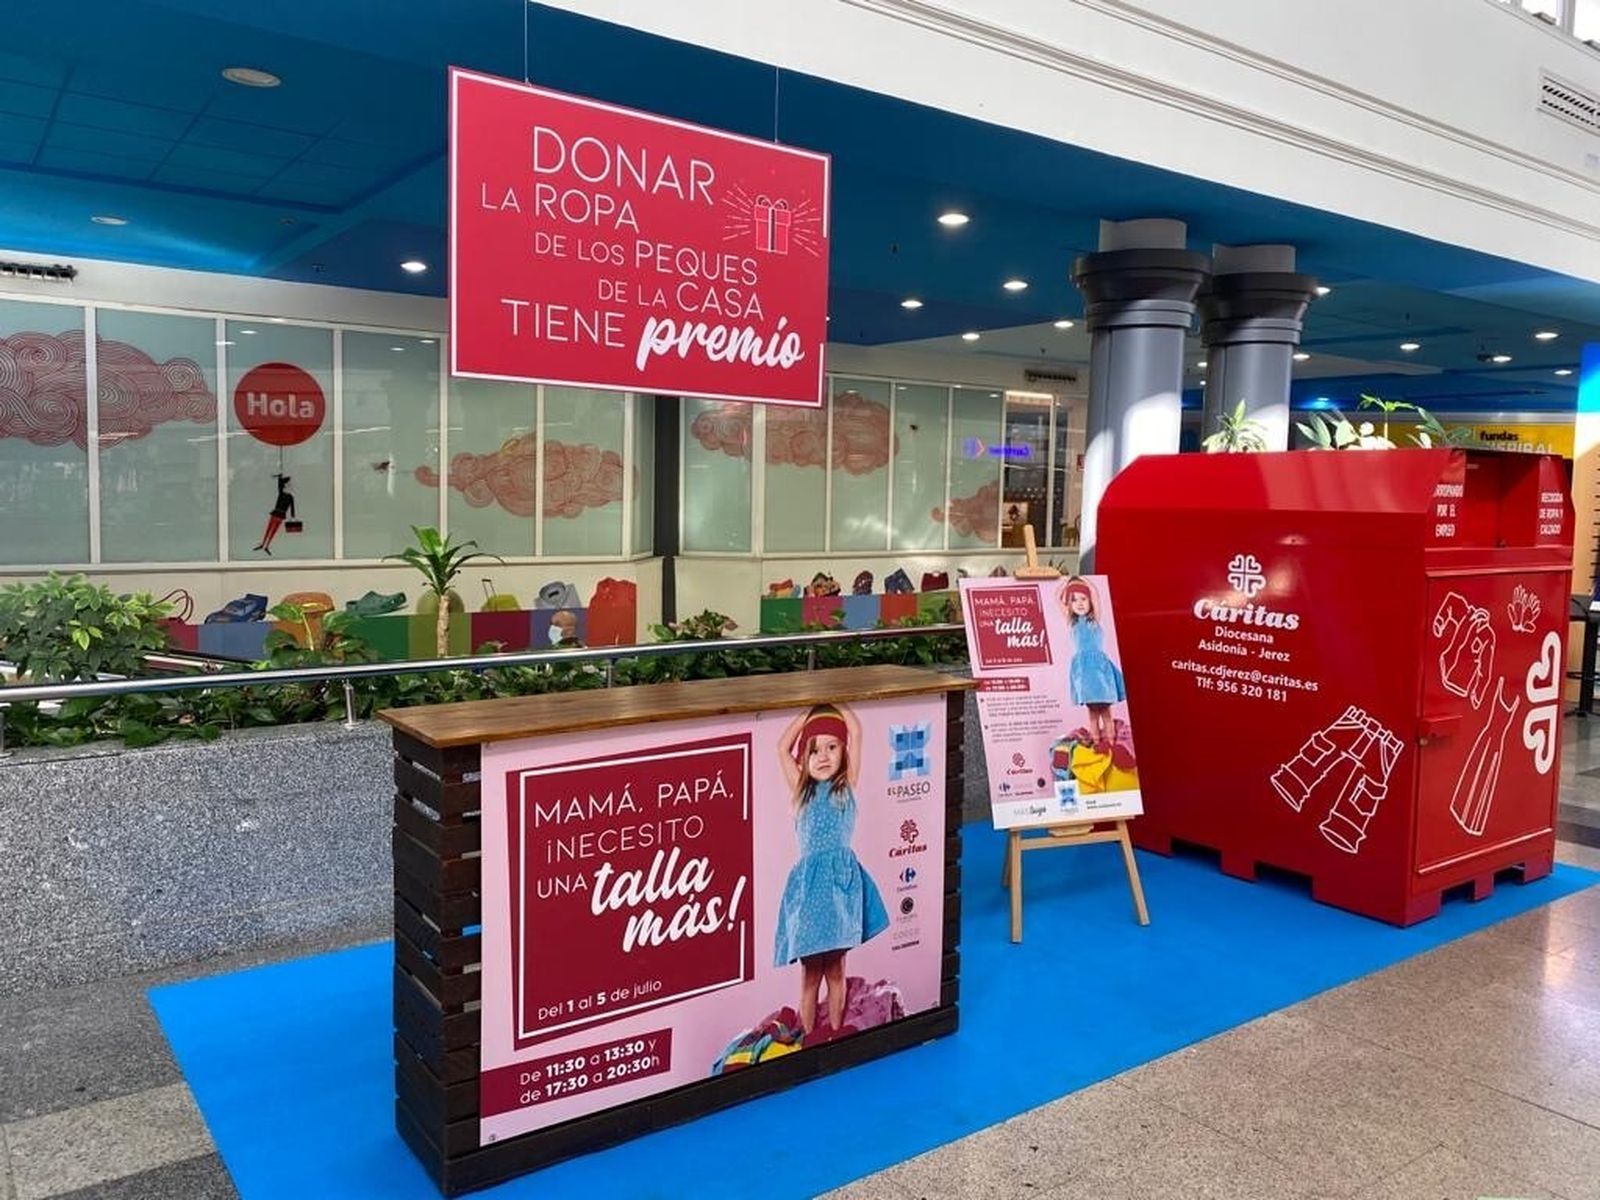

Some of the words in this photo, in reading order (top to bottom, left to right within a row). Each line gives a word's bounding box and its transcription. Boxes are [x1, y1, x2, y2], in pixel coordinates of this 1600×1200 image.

[533, 126, 715, 205] DONAR
[481, 182, 520, 213] LA
[535, 183, 640, 234] ROPA
[535, 232, 567, 257] DE
[577, 239, 625, 266] LOS
[635, 240, 758, 287] PEQUES
[598, 279, 628, 303] DE
[637, 284, 668, 309] LA
[676, 282, 764, 321] CASA
[501, 298, 626, 348] TIENE
[635, 316, 805, 372] premio
[247, 392, 315, 418] Hola
[1480, 430, 1518, 441] fundas
[995, 616, 1033, 635] talla
[1193, 598, 1300, 630] Cáritas
[1007, 629, 1045, 648] más!
[1198, 639, 1248, 656] Asidonia
[1259, 648, 1290, 662] Jerez
[1214, 626, 1274, 643] Diocesana
[1171, 659, 1319, 692] caritas.cdjerez@caritas.es
[1196, 676, 1214, 690] Tlf:
[1216, 680, 1238, 694] 956
[1241, 685, 1263, 698] 320
[1267, 689, 1287, 702] 181
[897, 781, 931, 797] PASEO
[537, 873, 588, 899] UNA
[591, 846, 714, 916] talla
[622, 875, 746, 953] más!
[538, 1003, 563, 1020] Del
[566, 1000, 574, 1013] 1
[578, 996, 592, 1010] al
[596, 991, 607, 1005] 5
[610, 988, 630, 1001] de
[633, 980, 662, 999] julio
[520, 1070, 541, 1085] De
[546, 1057, 585, 1077] 11:30
[590, 1055, 600, 1066] a
[604, 1041, 645, 1062] 13:30
[648, 1038, 657, 1051] y
[520, 1089, 541, 1104] de
[545, 1075, 588, 1096] 17:30
[592, 1072, 603, 1083] a
[607, 1055, 660, 1080] 20:30h
